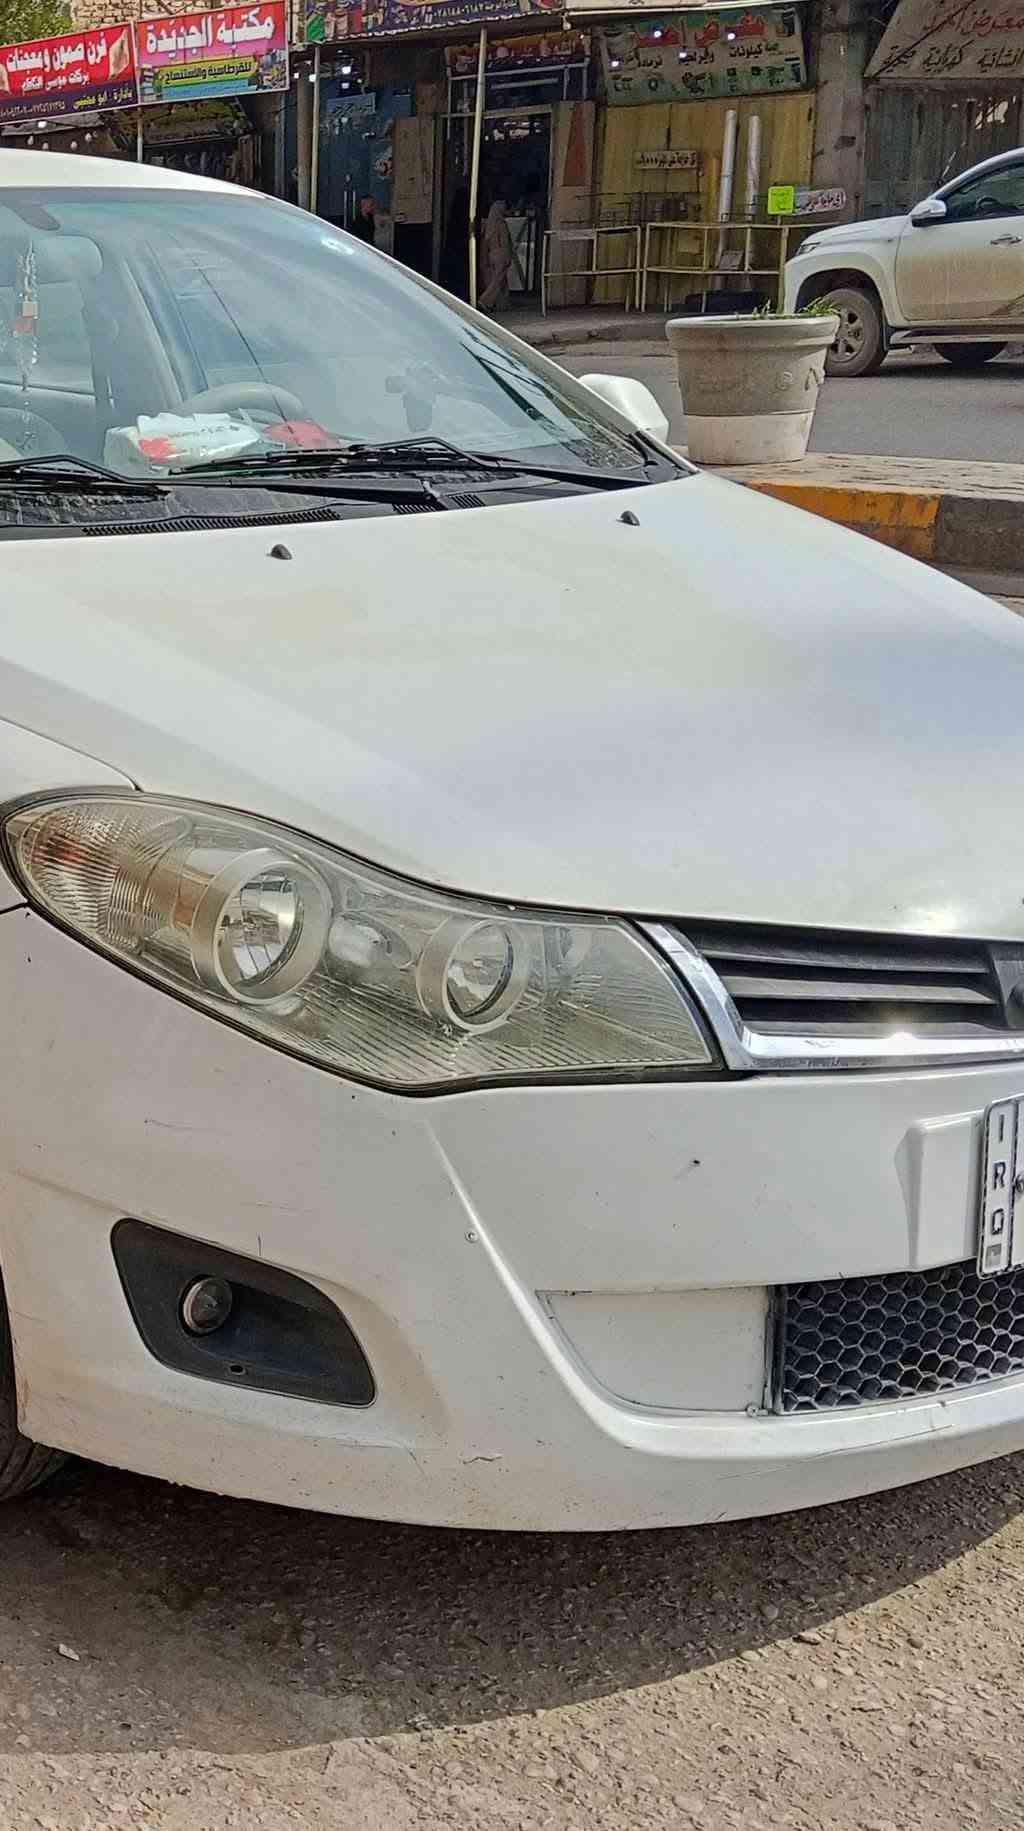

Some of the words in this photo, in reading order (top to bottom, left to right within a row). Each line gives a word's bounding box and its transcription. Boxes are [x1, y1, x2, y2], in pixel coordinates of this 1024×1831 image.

[217, 8, 274, 48] مكتبة
[53, 43, 85, 69] صمون
[87, 31, 107, 65] فرن
